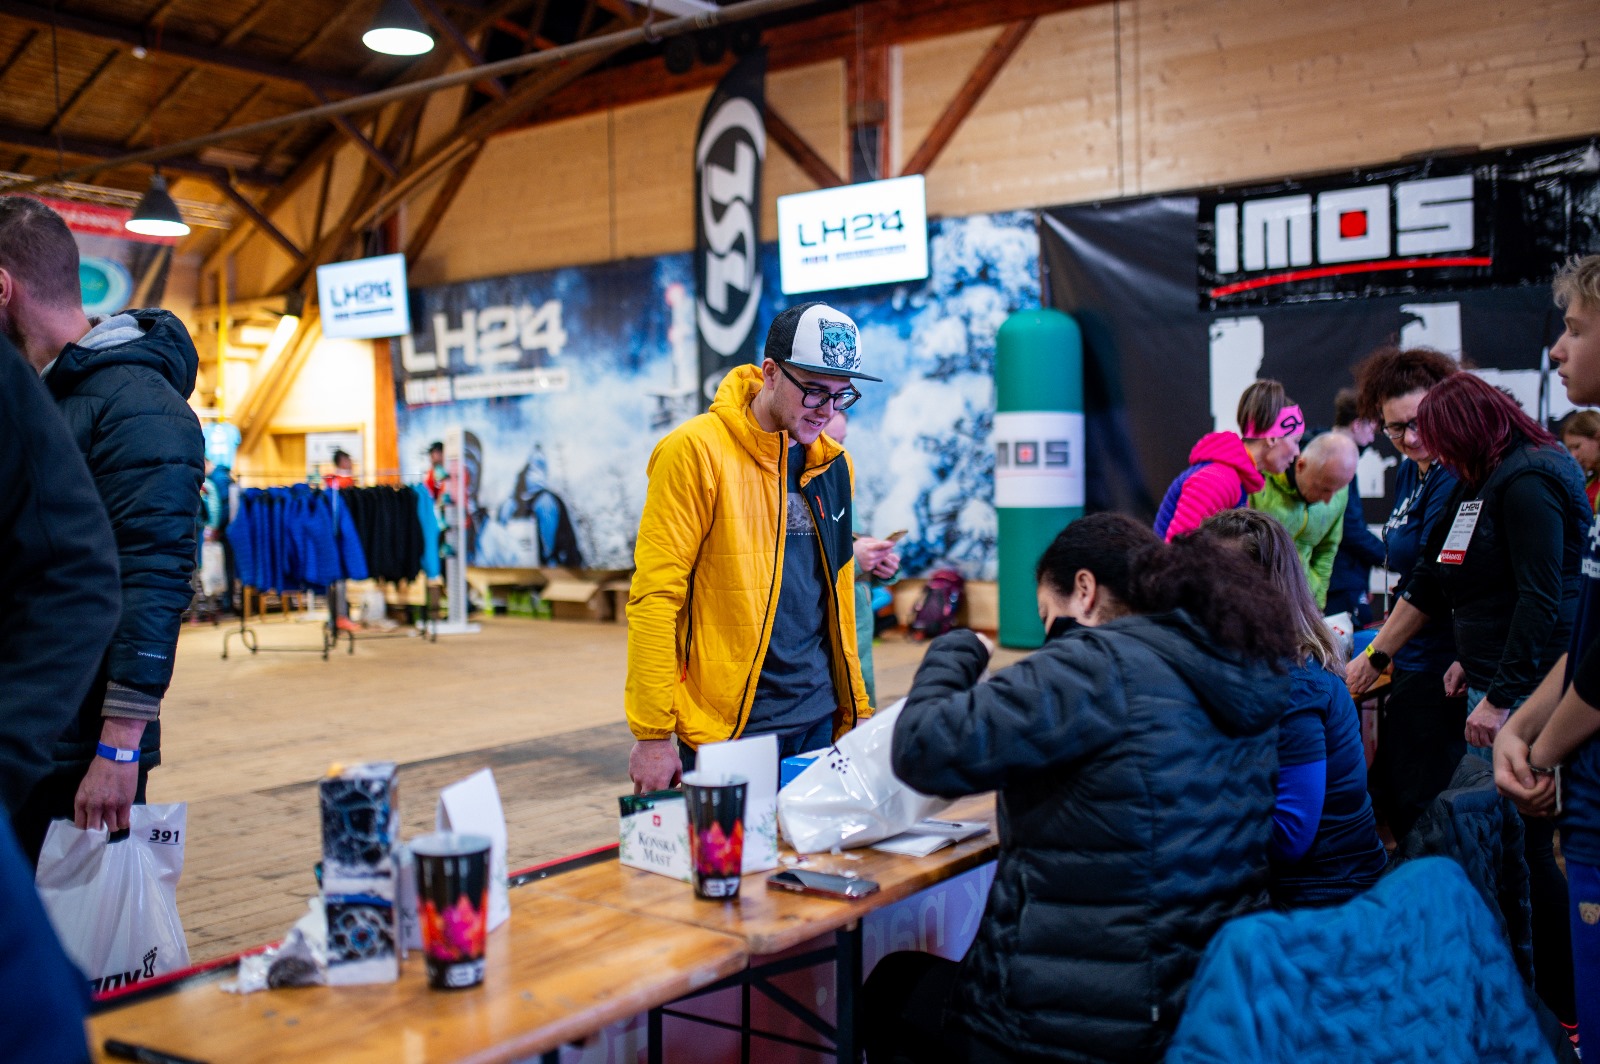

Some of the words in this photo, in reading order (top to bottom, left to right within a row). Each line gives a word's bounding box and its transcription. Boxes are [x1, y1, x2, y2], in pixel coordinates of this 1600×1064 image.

[798, 208, 905, 247] LH24
[1214, 174, 1475, 275] IMOS
[401, 299, 568, 373] LH24
[149, 829, 180, 843] 391
